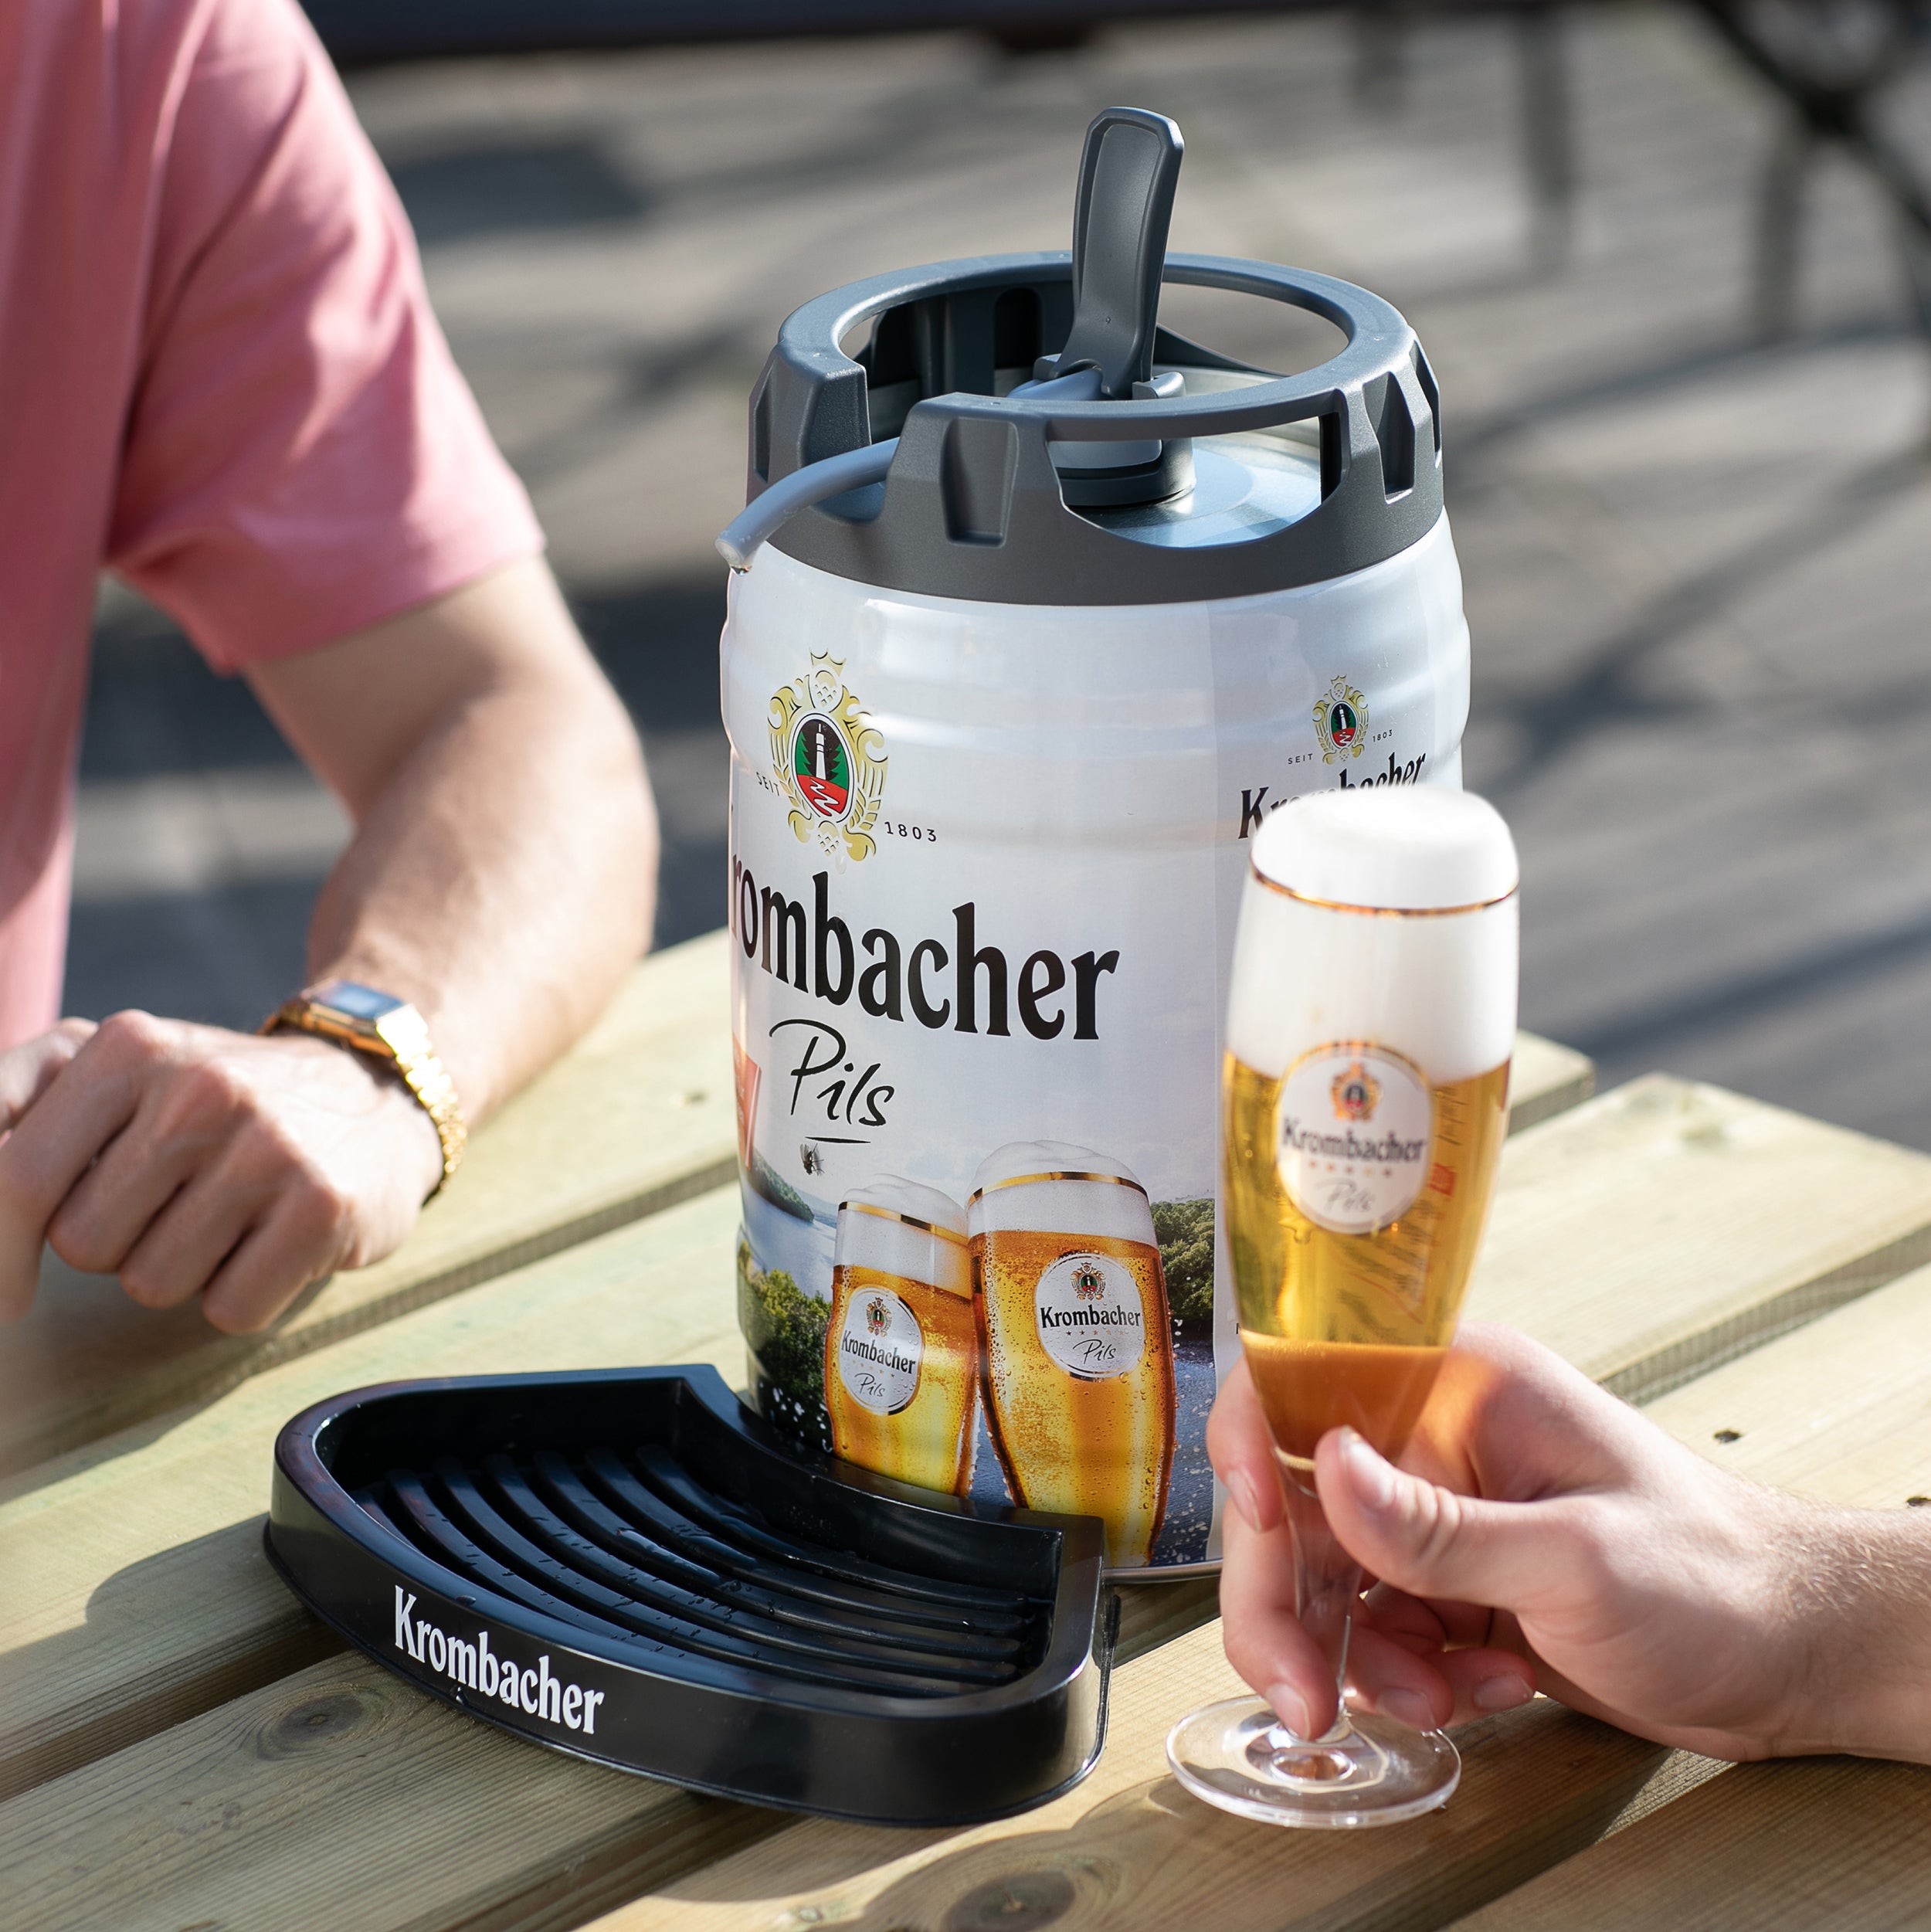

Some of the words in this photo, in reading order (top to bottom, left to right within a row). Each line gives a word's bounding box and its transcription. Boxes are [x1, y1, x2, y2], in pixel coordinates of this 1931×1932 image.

[1373, 730, 1393, 742] 1803
[1288, 753, 1313, 765] SEIT
[756, 772, 780, 796] SEIT
[884, 821, 937, 842] 1803
[731, 854, 1120, 1040] rombacher
[769, 1019, 894, 1126] Pils
[1040, 1304, 1141, 1328] Krombacher
[841, 1330, 915, 1373] Krombacher
[1072, 1339, 1116, 1364] Pils
[854, 1373, 885, 1397] Pils
[394, 1585, 605, 1735] Krombacher
